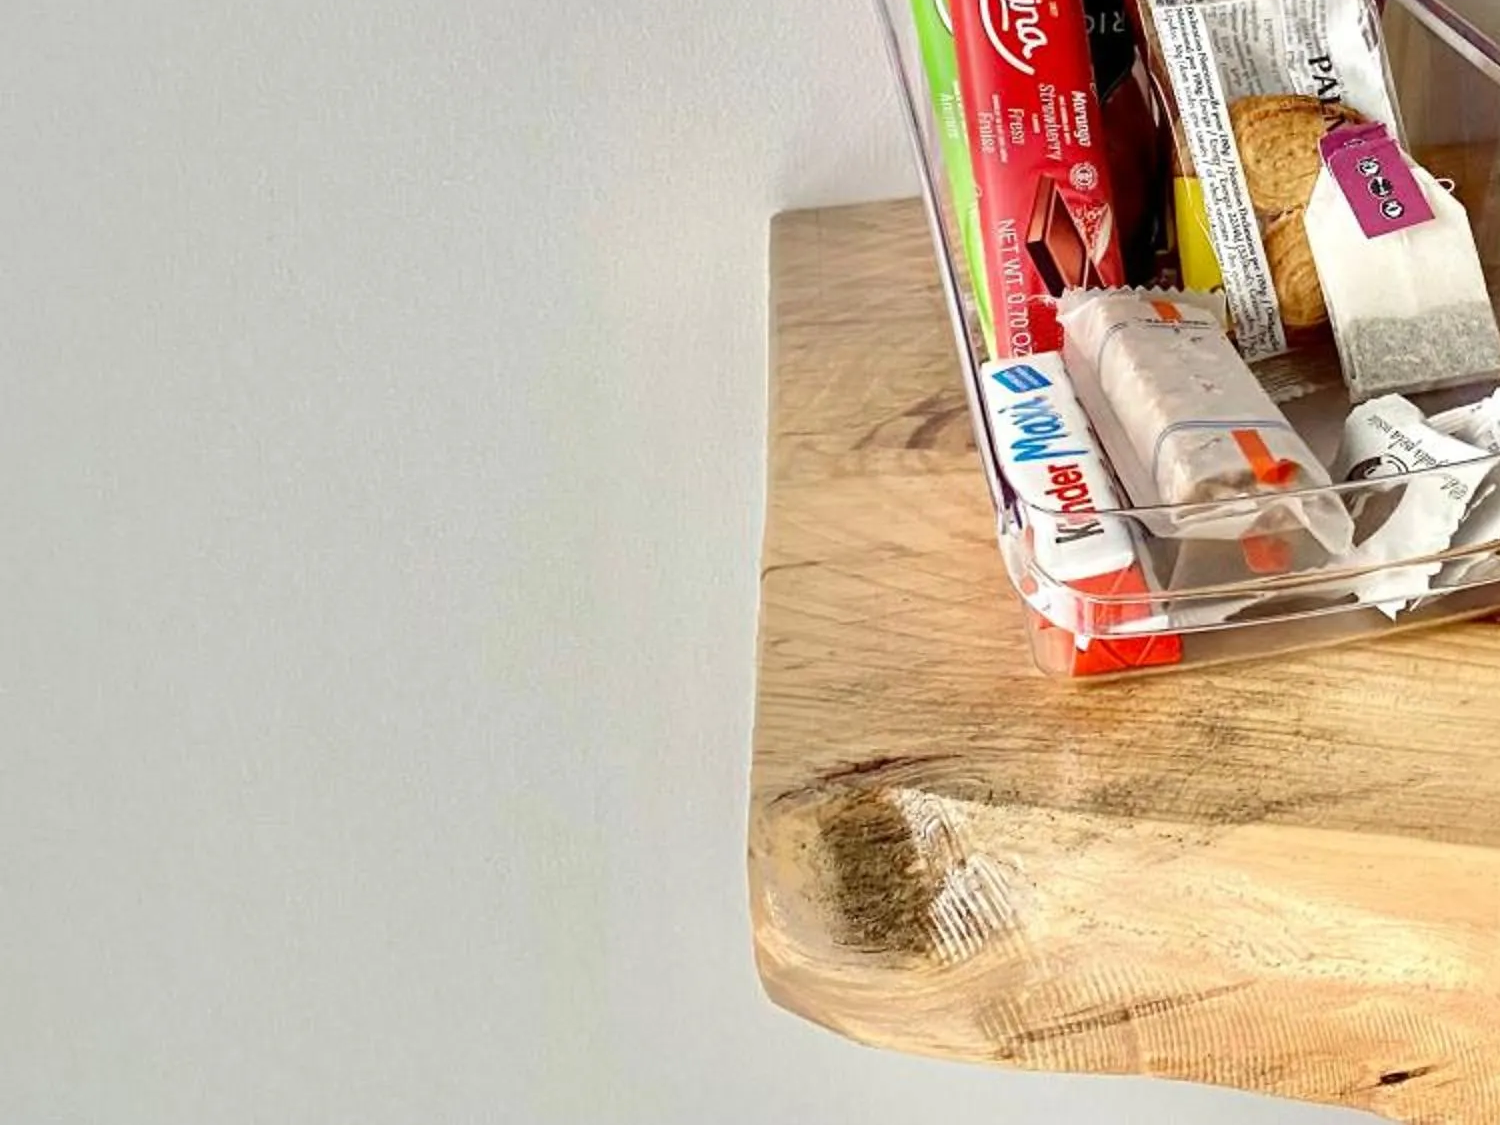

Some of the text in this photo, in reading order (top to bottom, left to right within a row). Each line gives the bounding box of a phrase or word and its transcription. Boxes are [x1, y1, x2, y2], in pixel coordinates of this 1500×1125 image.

[1008, 108, 1025, 145] Fresa
[1038, 82, 1063, 161] Strawberry
[1071, 90, 1093, 147] Morango
[998, 218, 1019, 252] NET
[998, 395, 1089, 462] Maxi
